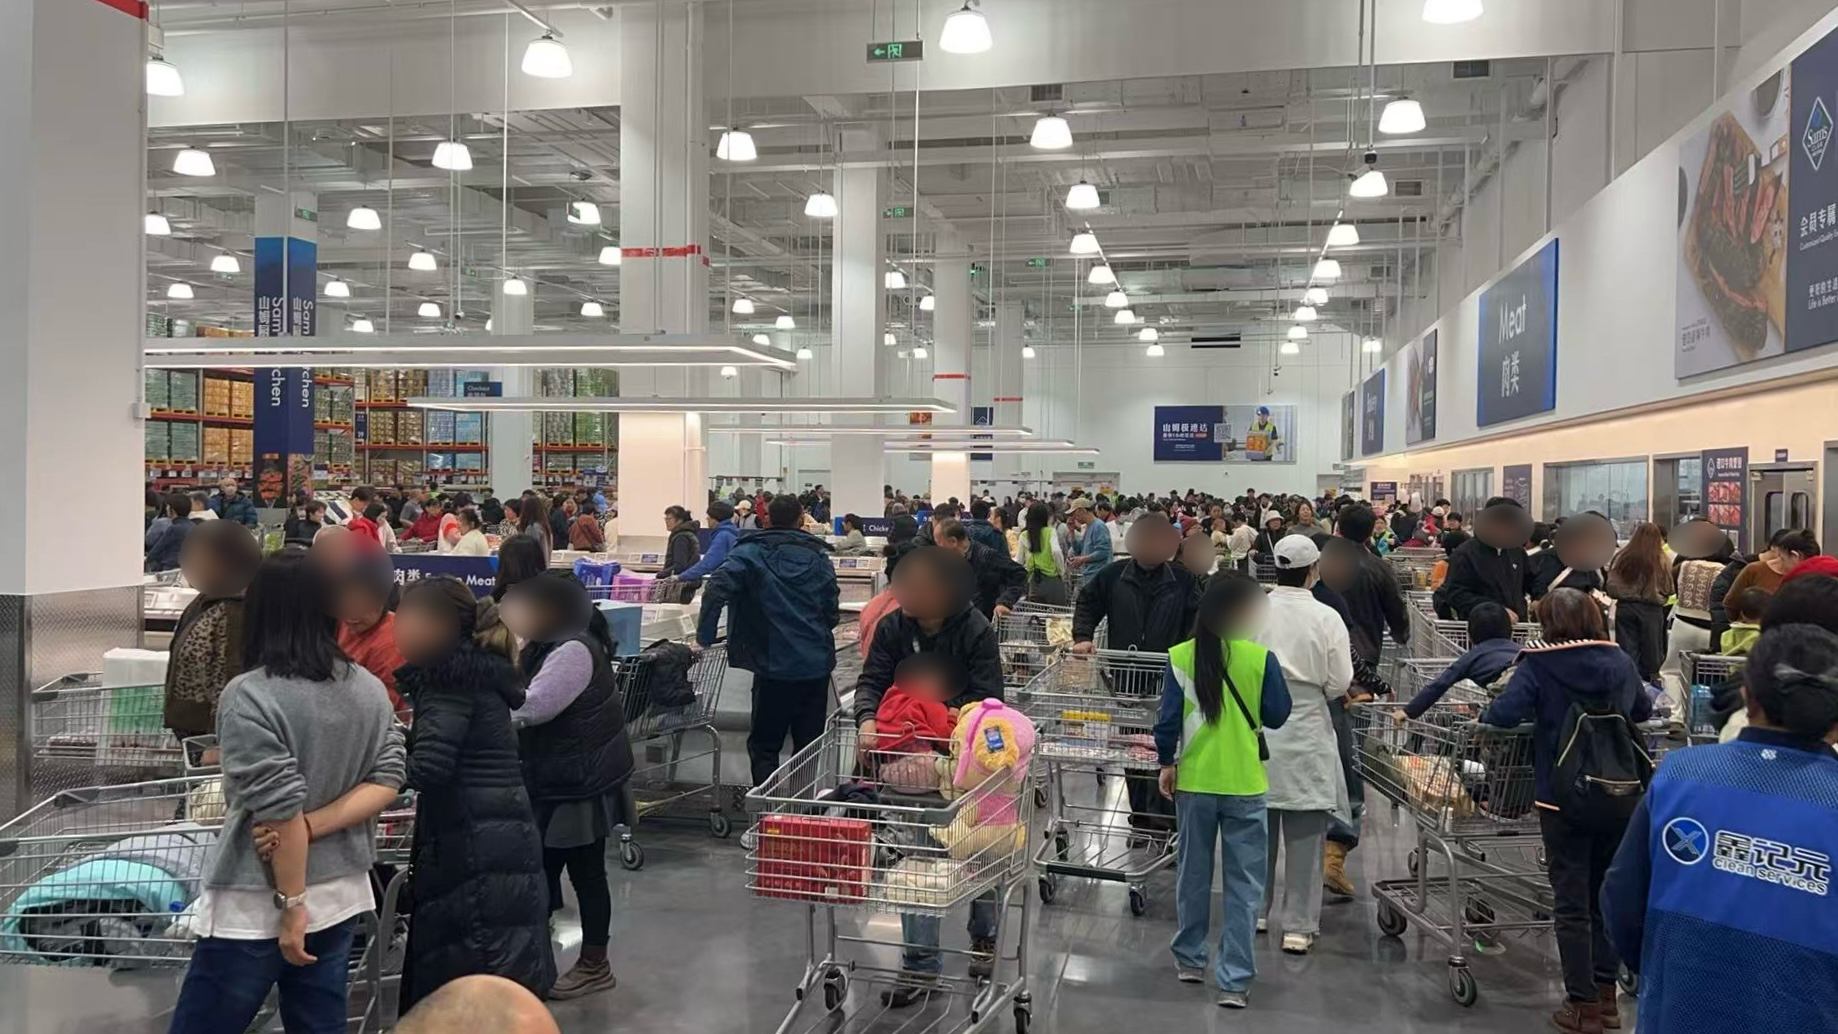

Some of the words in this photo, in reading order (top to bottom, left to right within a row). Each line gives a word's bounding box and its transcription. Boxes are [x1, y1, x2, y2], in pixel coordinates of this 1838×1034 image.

[1800, 203, 1837, 238] 会员专属
[272, 296, 284, 333] Sam
[303, 299, 314, 335] Sam
[1499, 294, 1527, 344] Meat
[271, 368, 286, 407] chen
[1501, 350, 1520, 398] 肉类
[868, 524, 889, 532] Chicke
[466, 574, 497, 586] Meat
[1713, 858, 1755, 877] clean
[1756, 867, 1827, 895] services
